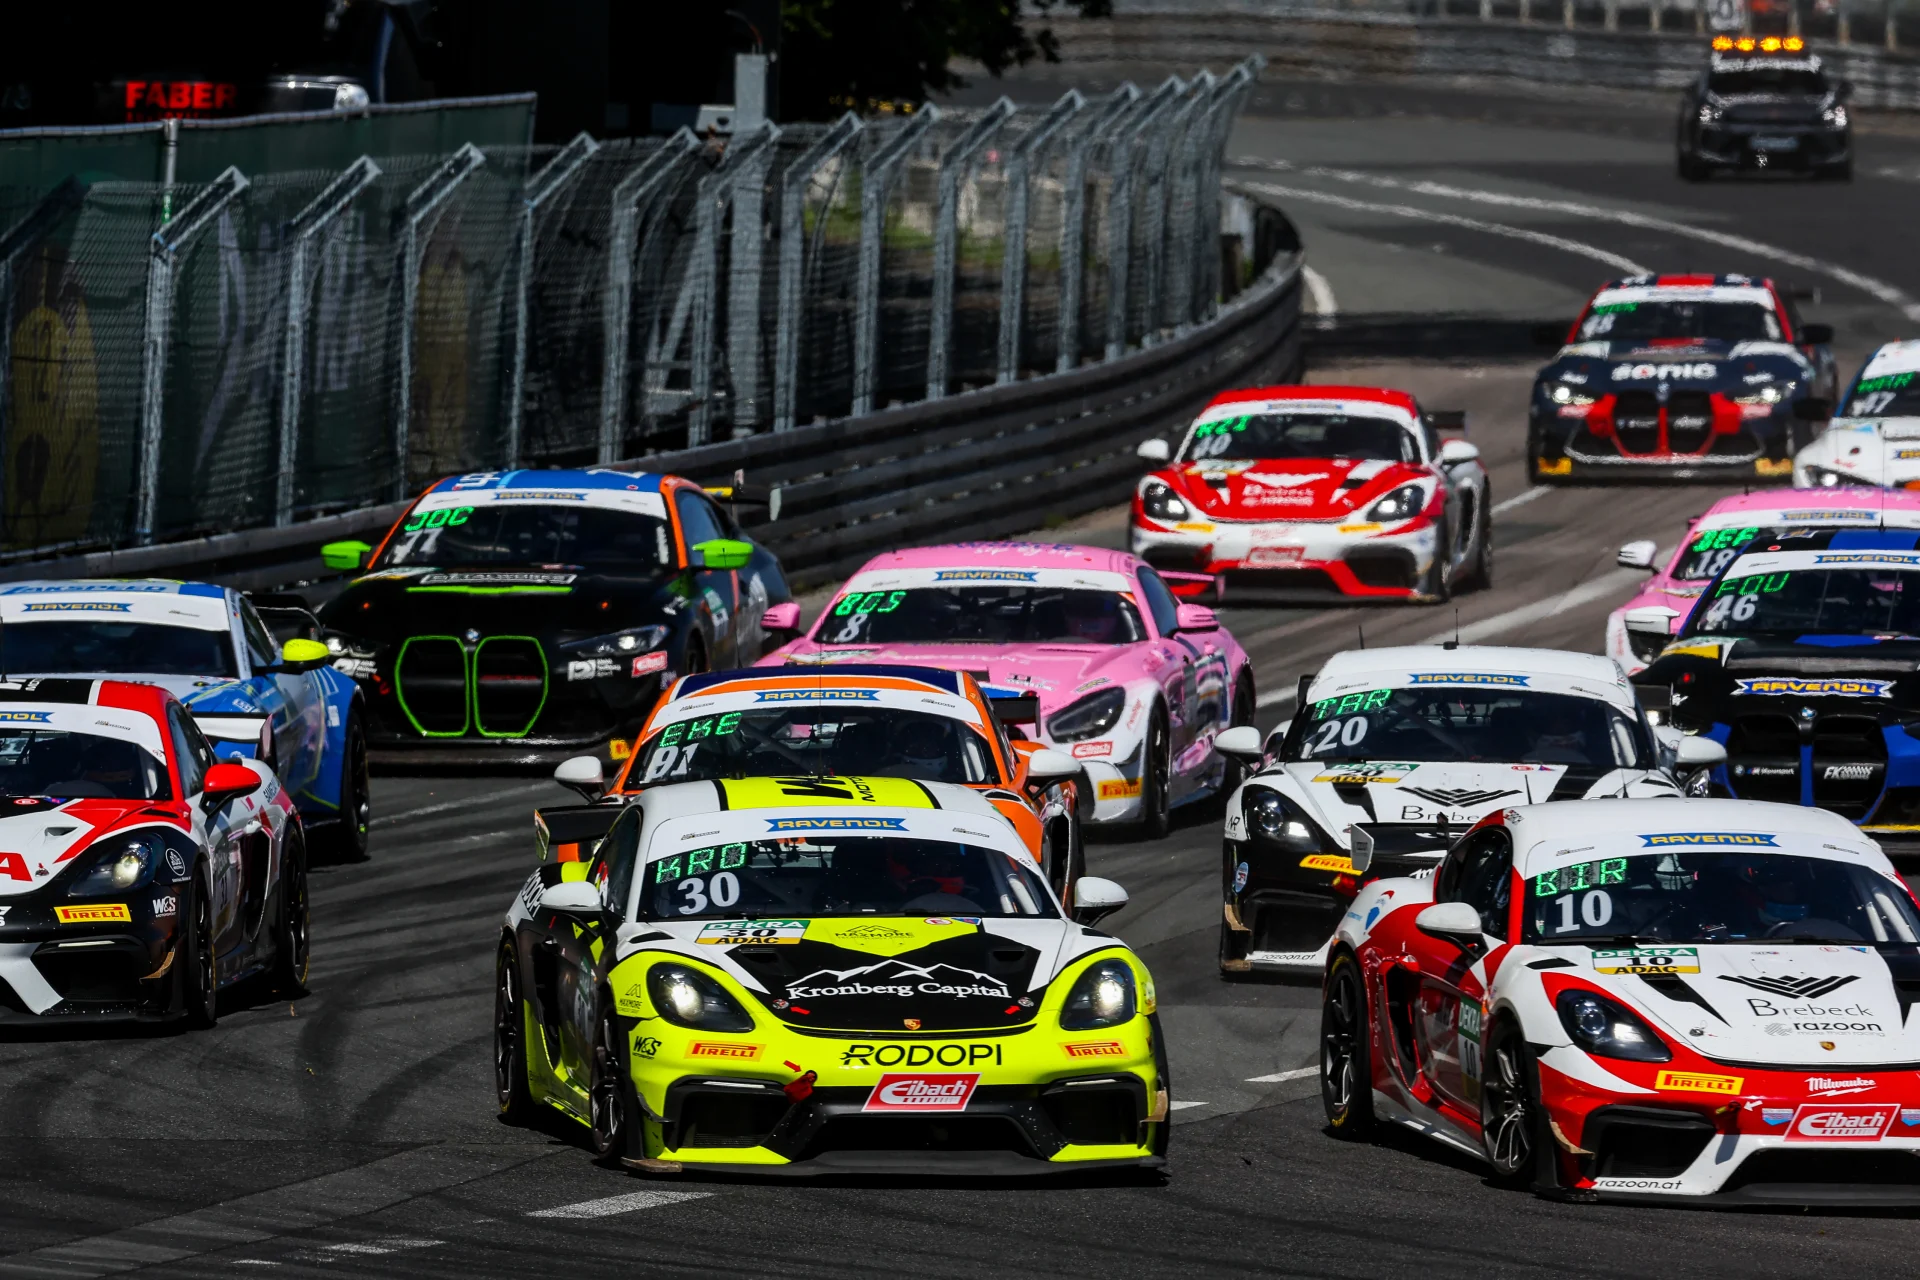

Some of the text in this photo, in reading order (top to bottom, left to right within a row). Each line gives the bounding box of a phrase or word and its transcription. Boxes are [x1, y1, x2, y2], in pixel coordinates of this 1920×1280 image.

[125, 81, 238, 109] FABER
[1611, 363, 1718, 380] sonic
[405, 505, 475, 531] JOC
[1821, 554, 1914, 563] RAVENOL
[942, 572, 1031, 581] RAVENOL
[30, 602, 123, 611] RAVENOL
[1706, 594, 1759, 625] 46
[838, 613, 868, 643] 8
[1418, 675, 1522, 684] RAVENOL
[764, 690, 870, 700] RAVENOL
[1751, 681, 1876, 694] RAVENOL
[1316, 688, 1392, 719] TAR
[1314, 716, 1368, 753] 20
[641, 743, 700, 780] 91
[777, 819, 897, 828] RAVENOL
[1650, 834, 1769, 845] RAVENOL
[677, 871, 740, 915] 30
[62, 906, 125, 919] PIRELLI
[153, 896, 176, 914] W&S
[1555, 889, 1613, 934] 10
[708, 920, 805, 930] DEKRA
[726, 929, 777, 937] 30
[1596, 949, 1694, 957] DEKRA
[1626, 956, 1673, 966] 10
[1615, 966, 1679, 974] ADAC
[786, 982, 1012, 999] Kronberg Capital
[1747, 998, 1874, 1016] Brebeck
[1793, 1022, 1882, 1031] razoon
[692, 1043, 757, 1057] PIRELLI
[839, 1044, 1002, 1066] RODOPI
[1065, 1042, 1123, 1057] PIRELLI
[1663, 1073, 1735, 1091] PIRELLI
[1804, 1077, 1877, 1092] Milwaukee
[879, 1080, 968, 1105] Eibach
[1797, 1112, 1886, 1136] Eibach
[1599, 1179, 1683, 1190] razoon.at
